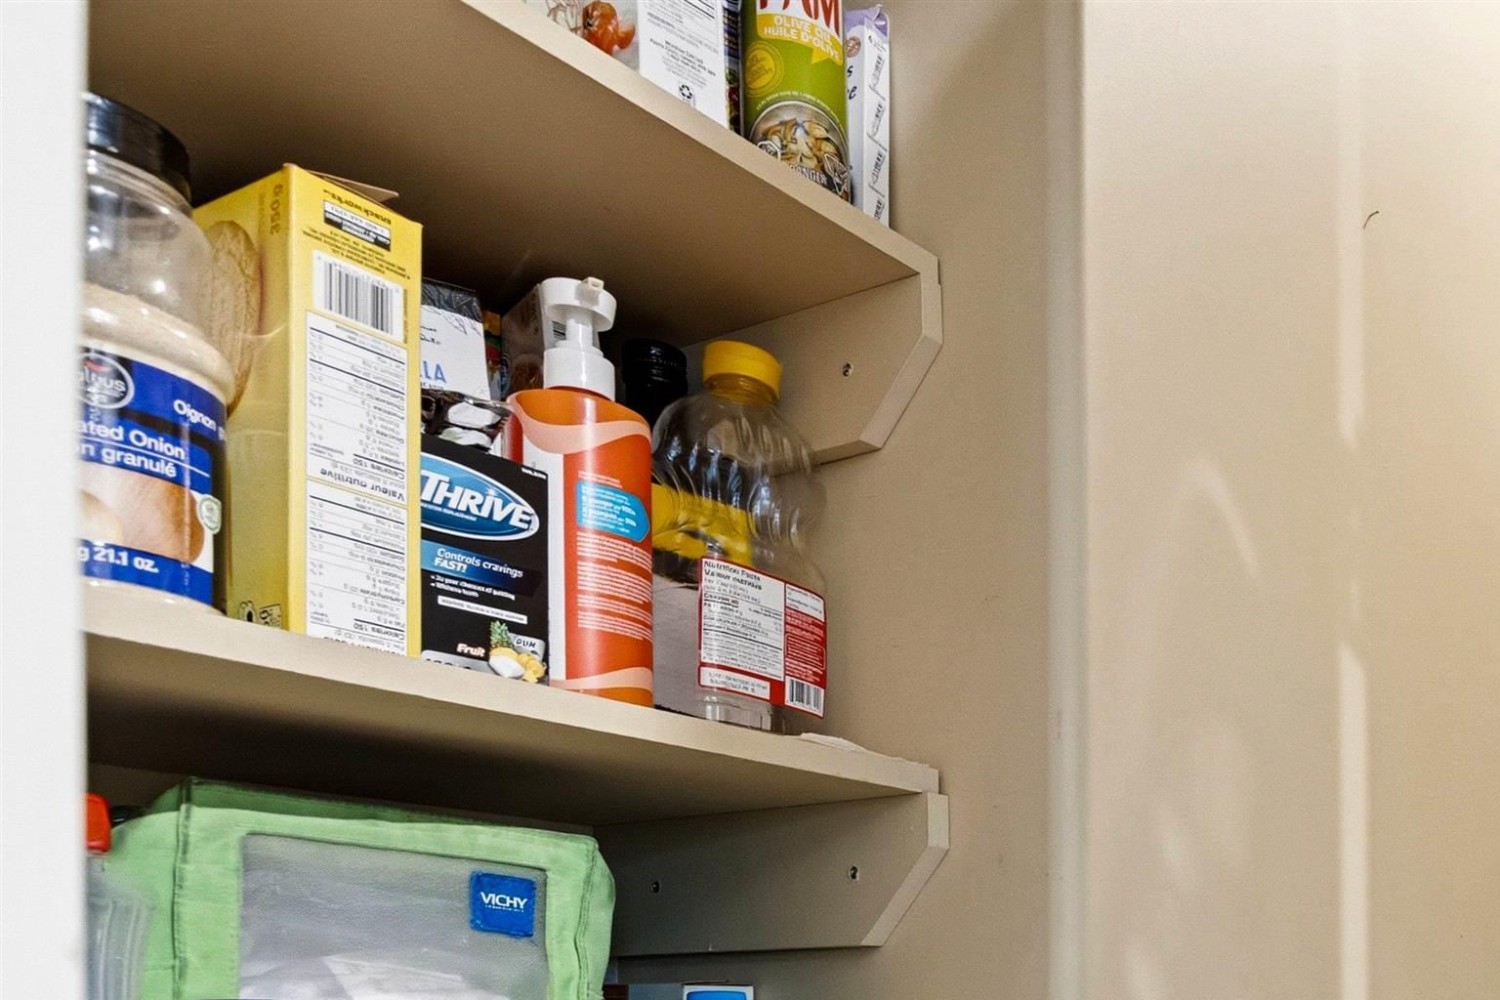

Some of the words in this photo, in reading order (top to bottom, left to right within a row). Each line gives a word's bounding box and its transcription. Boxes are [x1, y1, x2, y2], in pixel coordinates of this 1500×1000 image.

[173, 399, 217, 431] Oignon
[128, 429, 187, 461] Onion
[101, 448, 178, 478] granulé
[421, 468, 534, 530] THRIVE
[434, 557, 468, 574] FAST!
[437, 547, 481, 568] Controls
[482, 560, 524, 579] cravings
[456, 643, 486, 658] Fruit
[481, 891, 527, 909] VICHY
